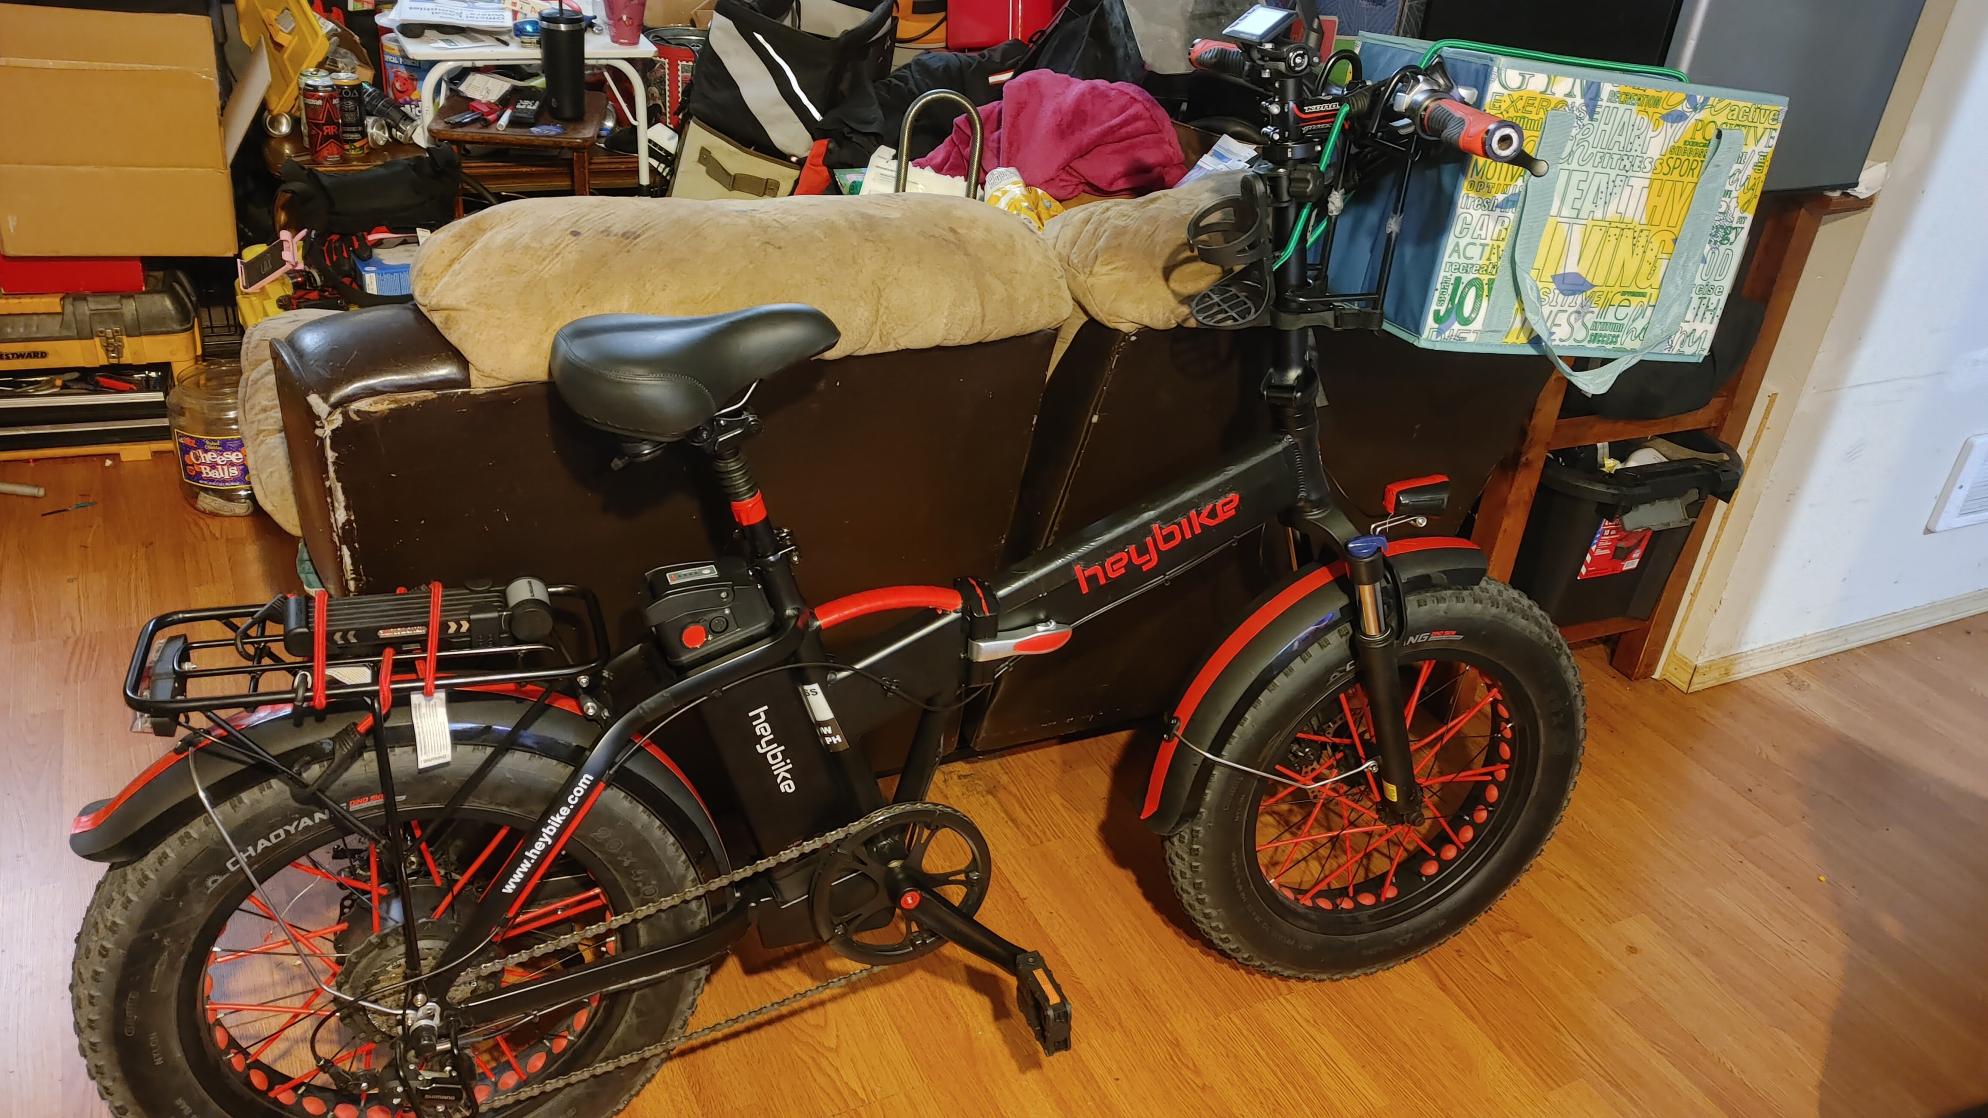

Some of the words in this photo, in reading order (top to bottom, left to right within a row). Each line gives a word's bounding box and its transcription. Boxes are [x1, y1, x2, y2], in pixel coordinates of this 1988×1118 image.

[1592, 105, 1681, 156] HAPPY
[1727, 104, 1780, 125] active
[1592, 151, 1664, 174] FITNESS
[1531, 221, 1679, 290] IVING
[0, 351, 48, 360] ESTWARD
[1587, 333, 1621, 345] SUCCESS
[190, 449, 244, 464] Cheese
[200, 464, 239, 479] Balls
[1074, 491, 1240, 594] heybike
[748, 705, 796, 794] heybike
[226, 803, 347, 872] CHAOYAN
[502, 773, 594, 894] www.heybike.com
